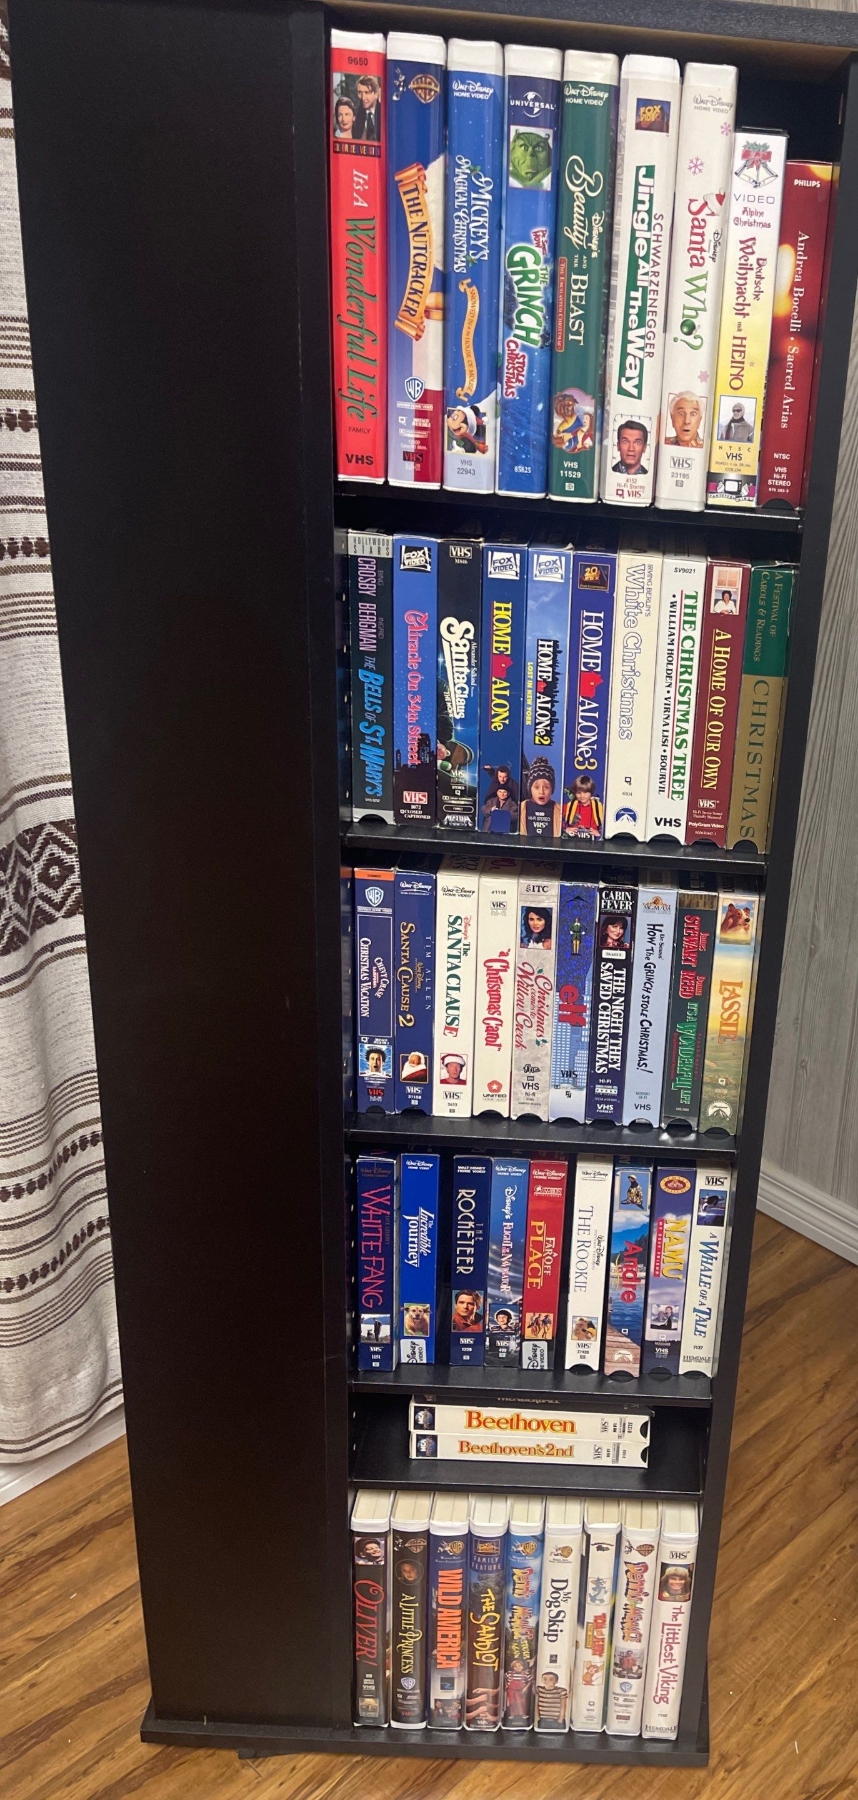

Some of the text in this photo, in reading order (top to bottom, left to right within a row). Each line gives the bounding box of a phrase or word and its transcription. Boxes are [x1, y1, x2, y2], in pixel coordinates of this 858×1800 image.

[347, 56, 369, 67] 9650
[510, 99, 556, 110] UNIVERSAL
[584, 98, 604, 106] VIDEO
[352, 168, 369, 192] It's
[353, 192, 369, 208] A
[733, 193, 776, 205] VIDEO
[793, 178, 821, 188] PHILIPS
[469, 170, 495, 260] MICKEY'S
[563, 155, 603, 250] Beauty
[733, 207, 771, 229] Alpine Christmas
[401, 184, 430, 318] THE NUTCRACKER
[687, 198, 716, 269] Santa
[336, 215, 378, 367] Wonderful
[506, 244, 545, 348] GRINCH
[539, 266, 549, 286] THE
[620, 166, 655, 398] Jingle All The Way
[645, 213, 664, 358] SCHWARZENEGGER
[752, 257, 768, 302] Deutsche
[568, 272, 589, 346] BEAST
[780, 230, 810, 429] Andrea Bocelli Sacred Arias
[504, 339, 519, 398] CHRISTMAS
[514, 353, 527, 387] STOLE
[729, 335, 747, 391] HEINO
[338, 365, 378, 422] Life
[348, 426, 371, 434] FAMILY
[345, 453, 374, 466] VHS
[457, 468, 476, 476] 22943
[460, 459, 473, 467] VHS
[671, 457, 691, 468] VHS
[725, 452, 743, 461] VHS
[773, 452, 791, 460] NTSC
[767, 479, 792, 487] STEREO
[404, 550, 427, 560] FOX
[404, 558, 427, 567] VIDEO
[450, 546, 472, 558] VHS
[492, 557, 513, 566] FOX
[492, 564, 515, 572] VIDEO
[538, 559, 559, 567] FOX
[538, 566, 560, 575] VIDEO
[673, 567, 696, 575] SV9021
[645, 563, 653, 587] IRVING
[357, 556, 378, 652] CROSBY BERGMAN
[753, 570, 771, 663] CAROLS READINGS
[770, 582, 783, 623] FESTIVAL
[493, 601, 513, 655] HOME
[580, 610, 605, 672] HOME
[715, 629, 732, 642] A
[537, 640, 554, 682] HOME
[618, 563, 646, 741] White Christmas
[711, 646, 731, 692] HOME
[358, 668, 385, 714] BELLS
[404, 610, 429, 769] Miracle On Street
[657, 600, 678, 795] WILLIAM HOLDEN VIRNA LISI BOURVIL
[671, 591, 699, 802] THE CHRISTMAS TREE
[709, 696, 727, 718] OF
[525, 707, 533, 726] YORK
[706, 720, 724, 753] OUR
[359, 744, 386, 797] MARY'S
[702, 756, 721, 791] OWN
[738, 679, 771, 839] CHRISTMAS
[404, 792, 427, 804] VHS
[698, 800, 717, 809] VHS
[654, 816, 682, 828] VHS
[531, 885, 550, 893] ITC
[600, 899, 633, 911] FEVER
[601, 890, 633, 902] CABIN
[681, 914, 702, 969] STEWART
[359, 937, 372, 1018] CHRISTMAS VACATION
[397, 921, 416, 1028] SANTA CLAUSE 2
[515, 961, 536, 1012] Willow
[678, 969, 698, 1000] REED
[534, 974, 553, 1039] Christmas
[556, 983, 589, 1028] elf
[595, 961, 615, 1075] SAVED CHRISTMAS
[608, 967, 626, 1072] THE NIGHT THEY
[636, 961, 657, 1075] GRINCH STOLE CHRISTMAS!
[717, 980, 744, 1045] LASSIE
[521, 1082, 541, 1091] VHS
[560, 1069, 579, 1079] VHS
[444, 1091, 461, 1100] VHS
[634, 1103, 652, 1111] VHS
[705, 1176, 725, 1186] VHS
[361, 1184, 391, 1255] WHITE
[418, 1206, 436, 1257] Incredible
[456, 1188, 477, 1274] ROCKETEER
[474, 1223, 485, 1242] THE
[402, 1214, 420, 1268] Journey
[527, 1220, 545, 1290] PLACE
[573, 1205, 595, 1293] THE ROOKIE
[661, 1218, 688, 1281] NAMU
[361, 1256, 386, 1309] FANG
[620, 1240, 643, 1304] Andre
[692, 1240, 720, 1338] WHALE TALE
[464, 1409, 577, 1434] Beethoven
[458, 1439, 575, 1459] Beethoven's 2nd
[471, 1562, 502, 1571] FEATURE
[474, 1555, 500, 1564] FAMILY
[669, 1550, 688, 1560] VHS
[480, 1587, 496, 1612] THE
[543, 1578, 569, 1643] Dog Skip
[561, 1590, 573, 1605] My
[436, 1568, 463, 1669] WILD AMERICA
[396, 1628, 423, 1675] PRINCESS
[469, 1610, 501, 1672] SANDLOT
[652, 1606, 685, 1705] The Littlest Viking
